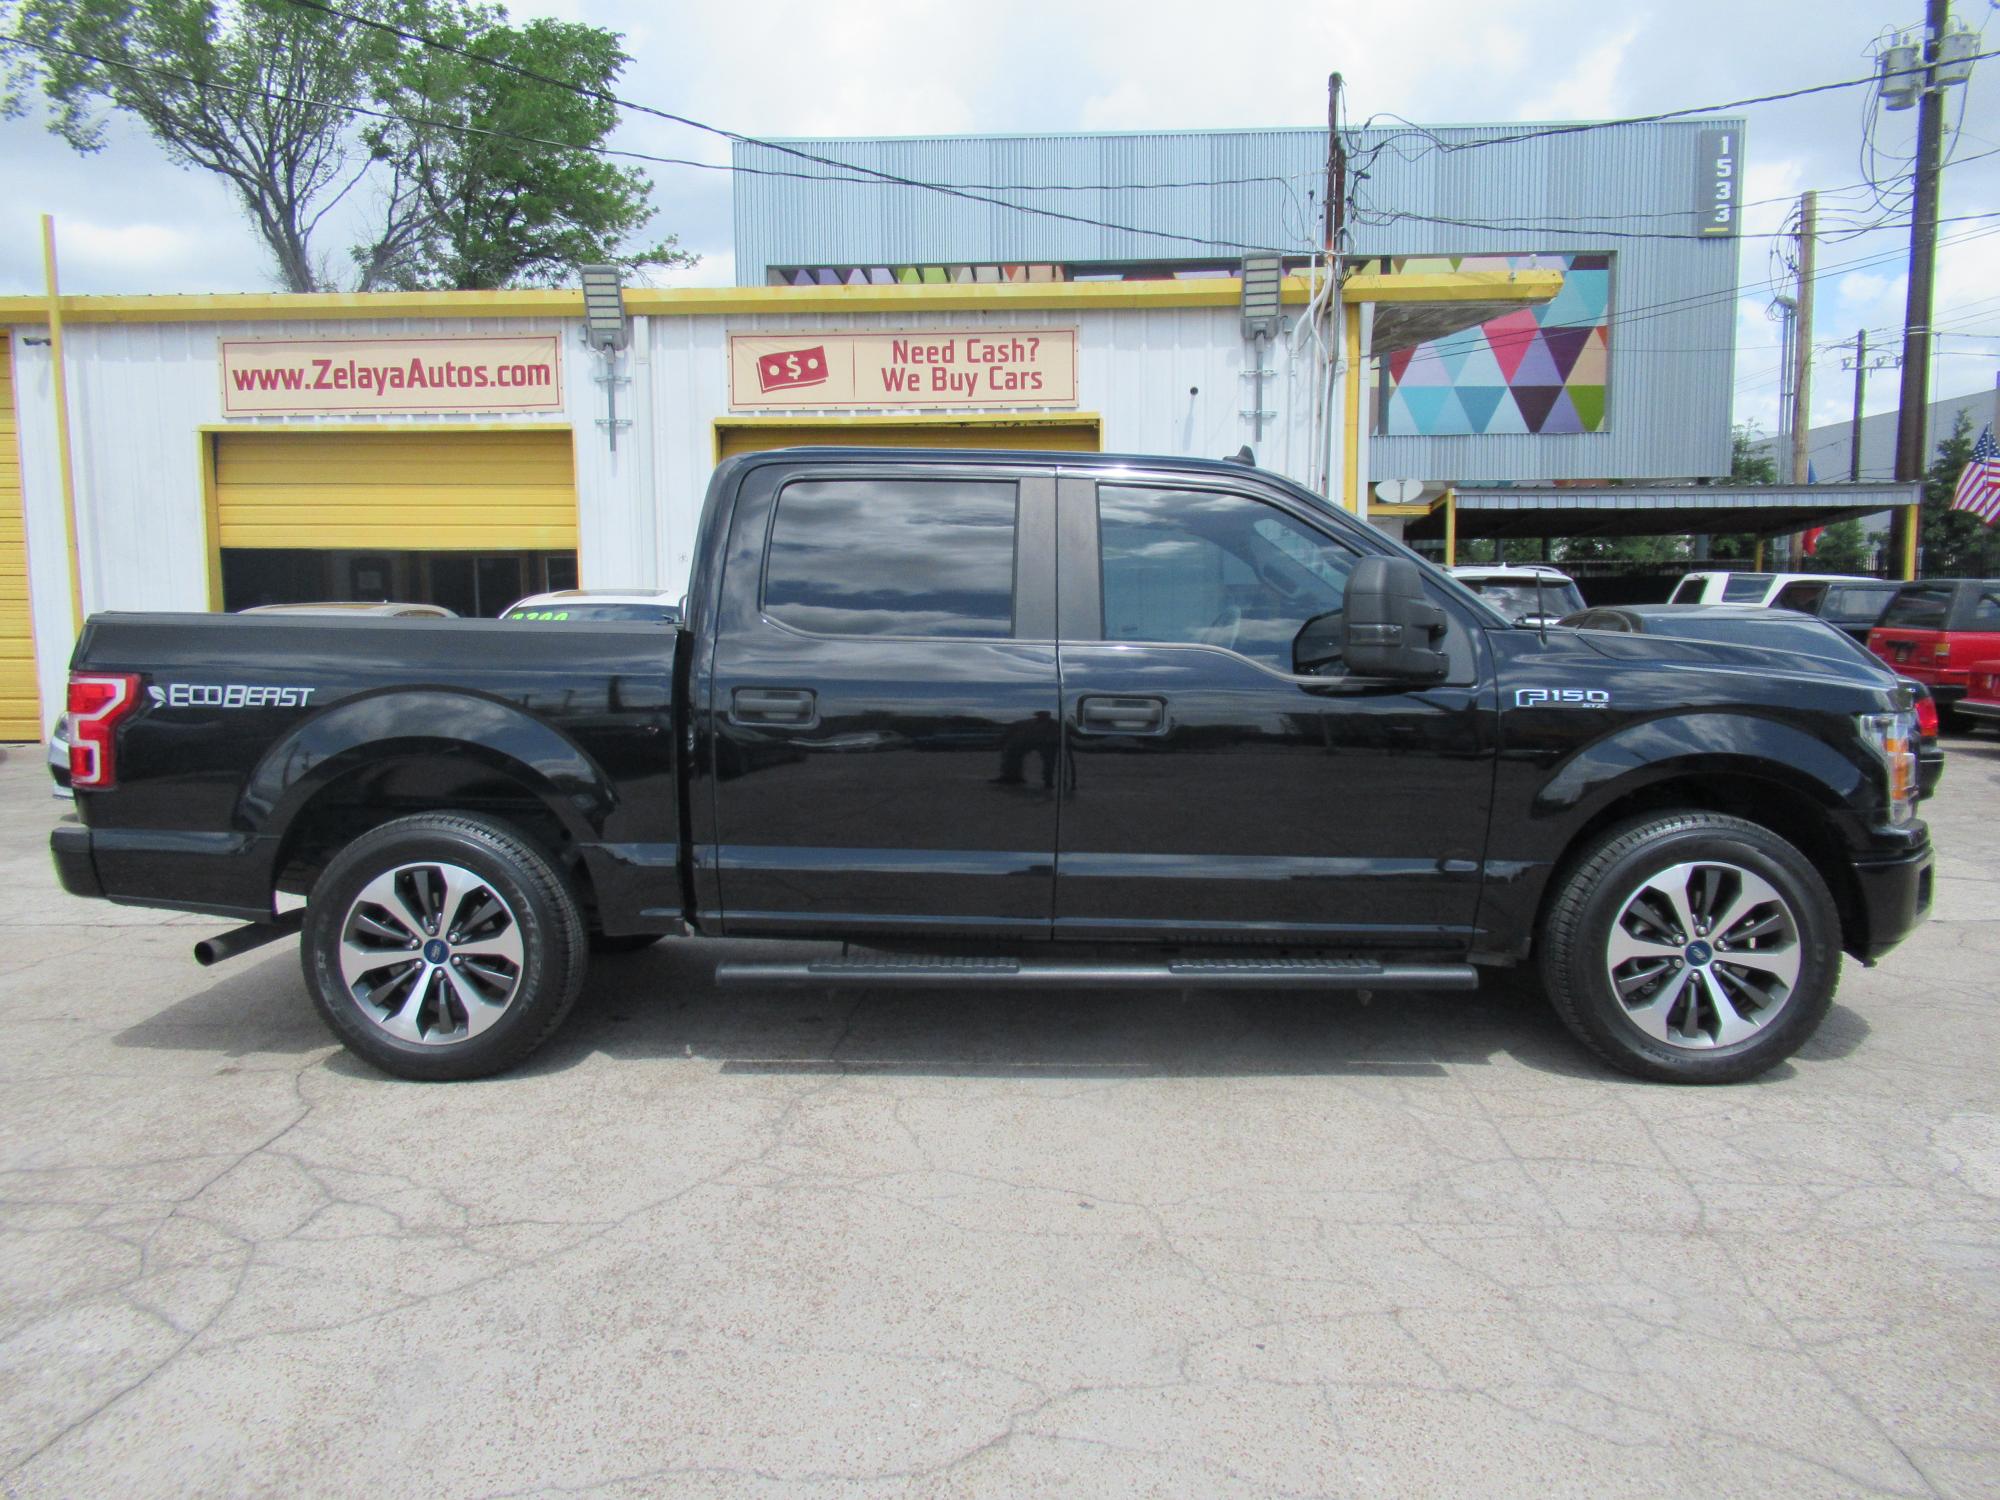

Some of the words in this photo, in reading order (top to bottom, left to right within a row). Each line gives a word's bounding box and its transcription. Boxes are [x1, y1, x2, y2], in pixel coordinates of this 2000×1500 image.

[1715, 135, 1732, 222] 1533
[892, 339, 955, 364] Need
[966, 337, 1040, 364] Cash?
[232, 357, 551, 396] www.ZelayaAutos.com
[881, 367, 921, 392] We
[931, 366, 979, 397] Buy
[989, 366, 1043, 391] Cars
